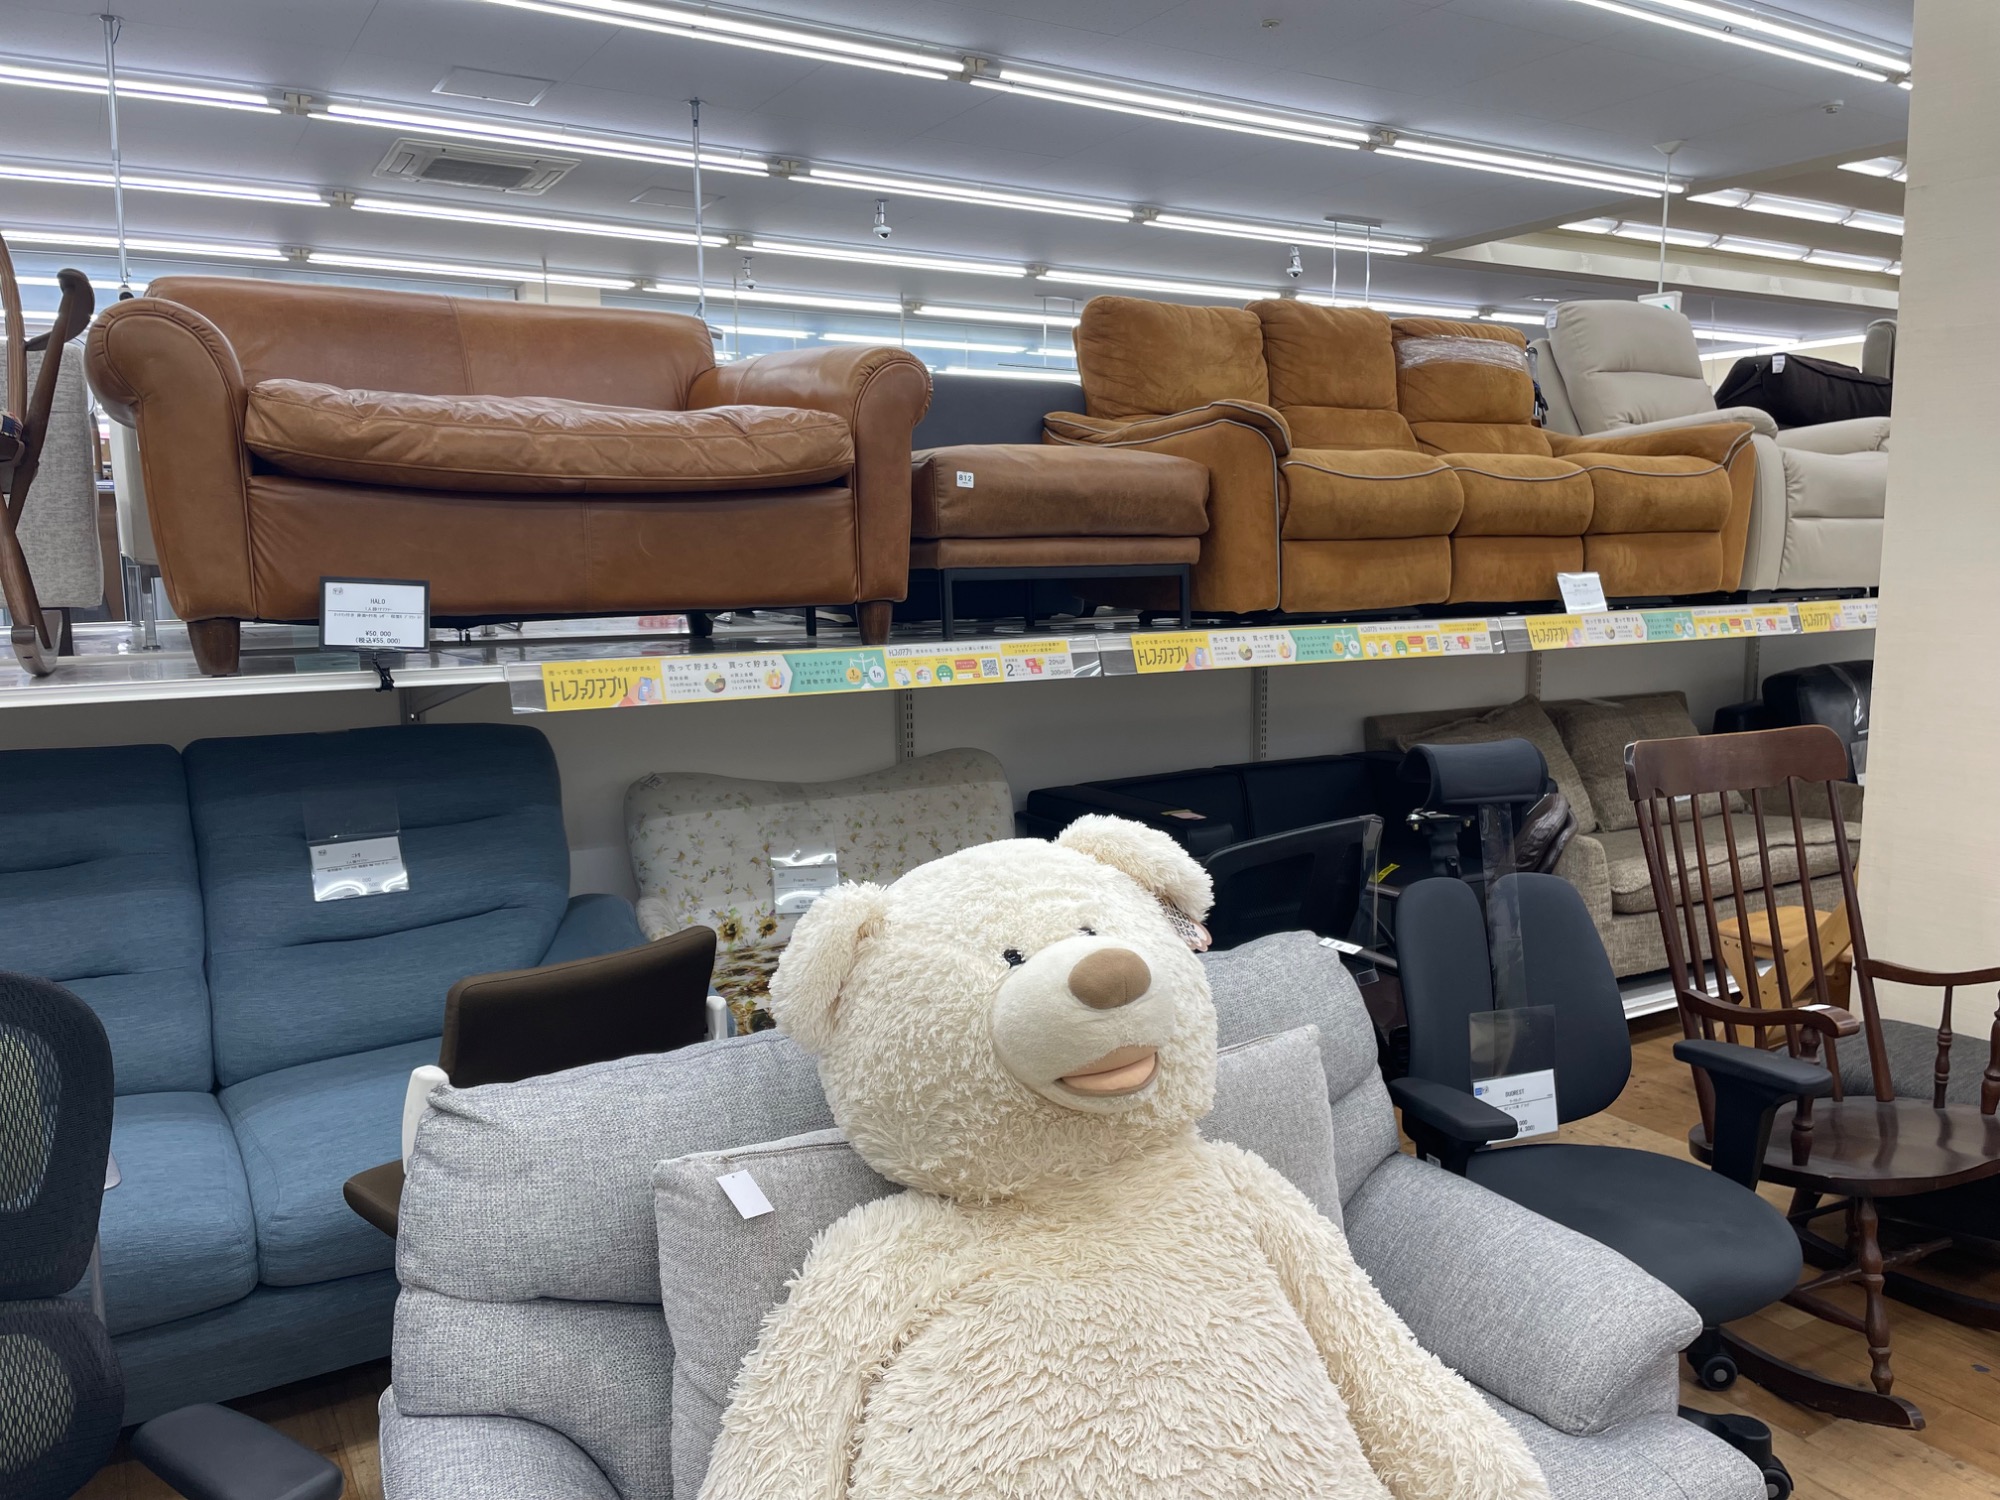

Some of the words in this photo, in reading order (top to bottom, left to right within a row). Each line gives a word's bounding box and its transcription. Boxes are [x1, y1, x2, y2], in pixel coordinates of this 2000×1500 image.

[958, 474, 972, 482] 812
[1138, 646, 1189, 666] トレファクアプリ
[667, 662, 718, 673] 売って貯まる
[728, 659, 777, 669] 買って貯まる
[1006, 664, 1015, 677] 2
[550, 676, 629, 702] トレファクアプリ
